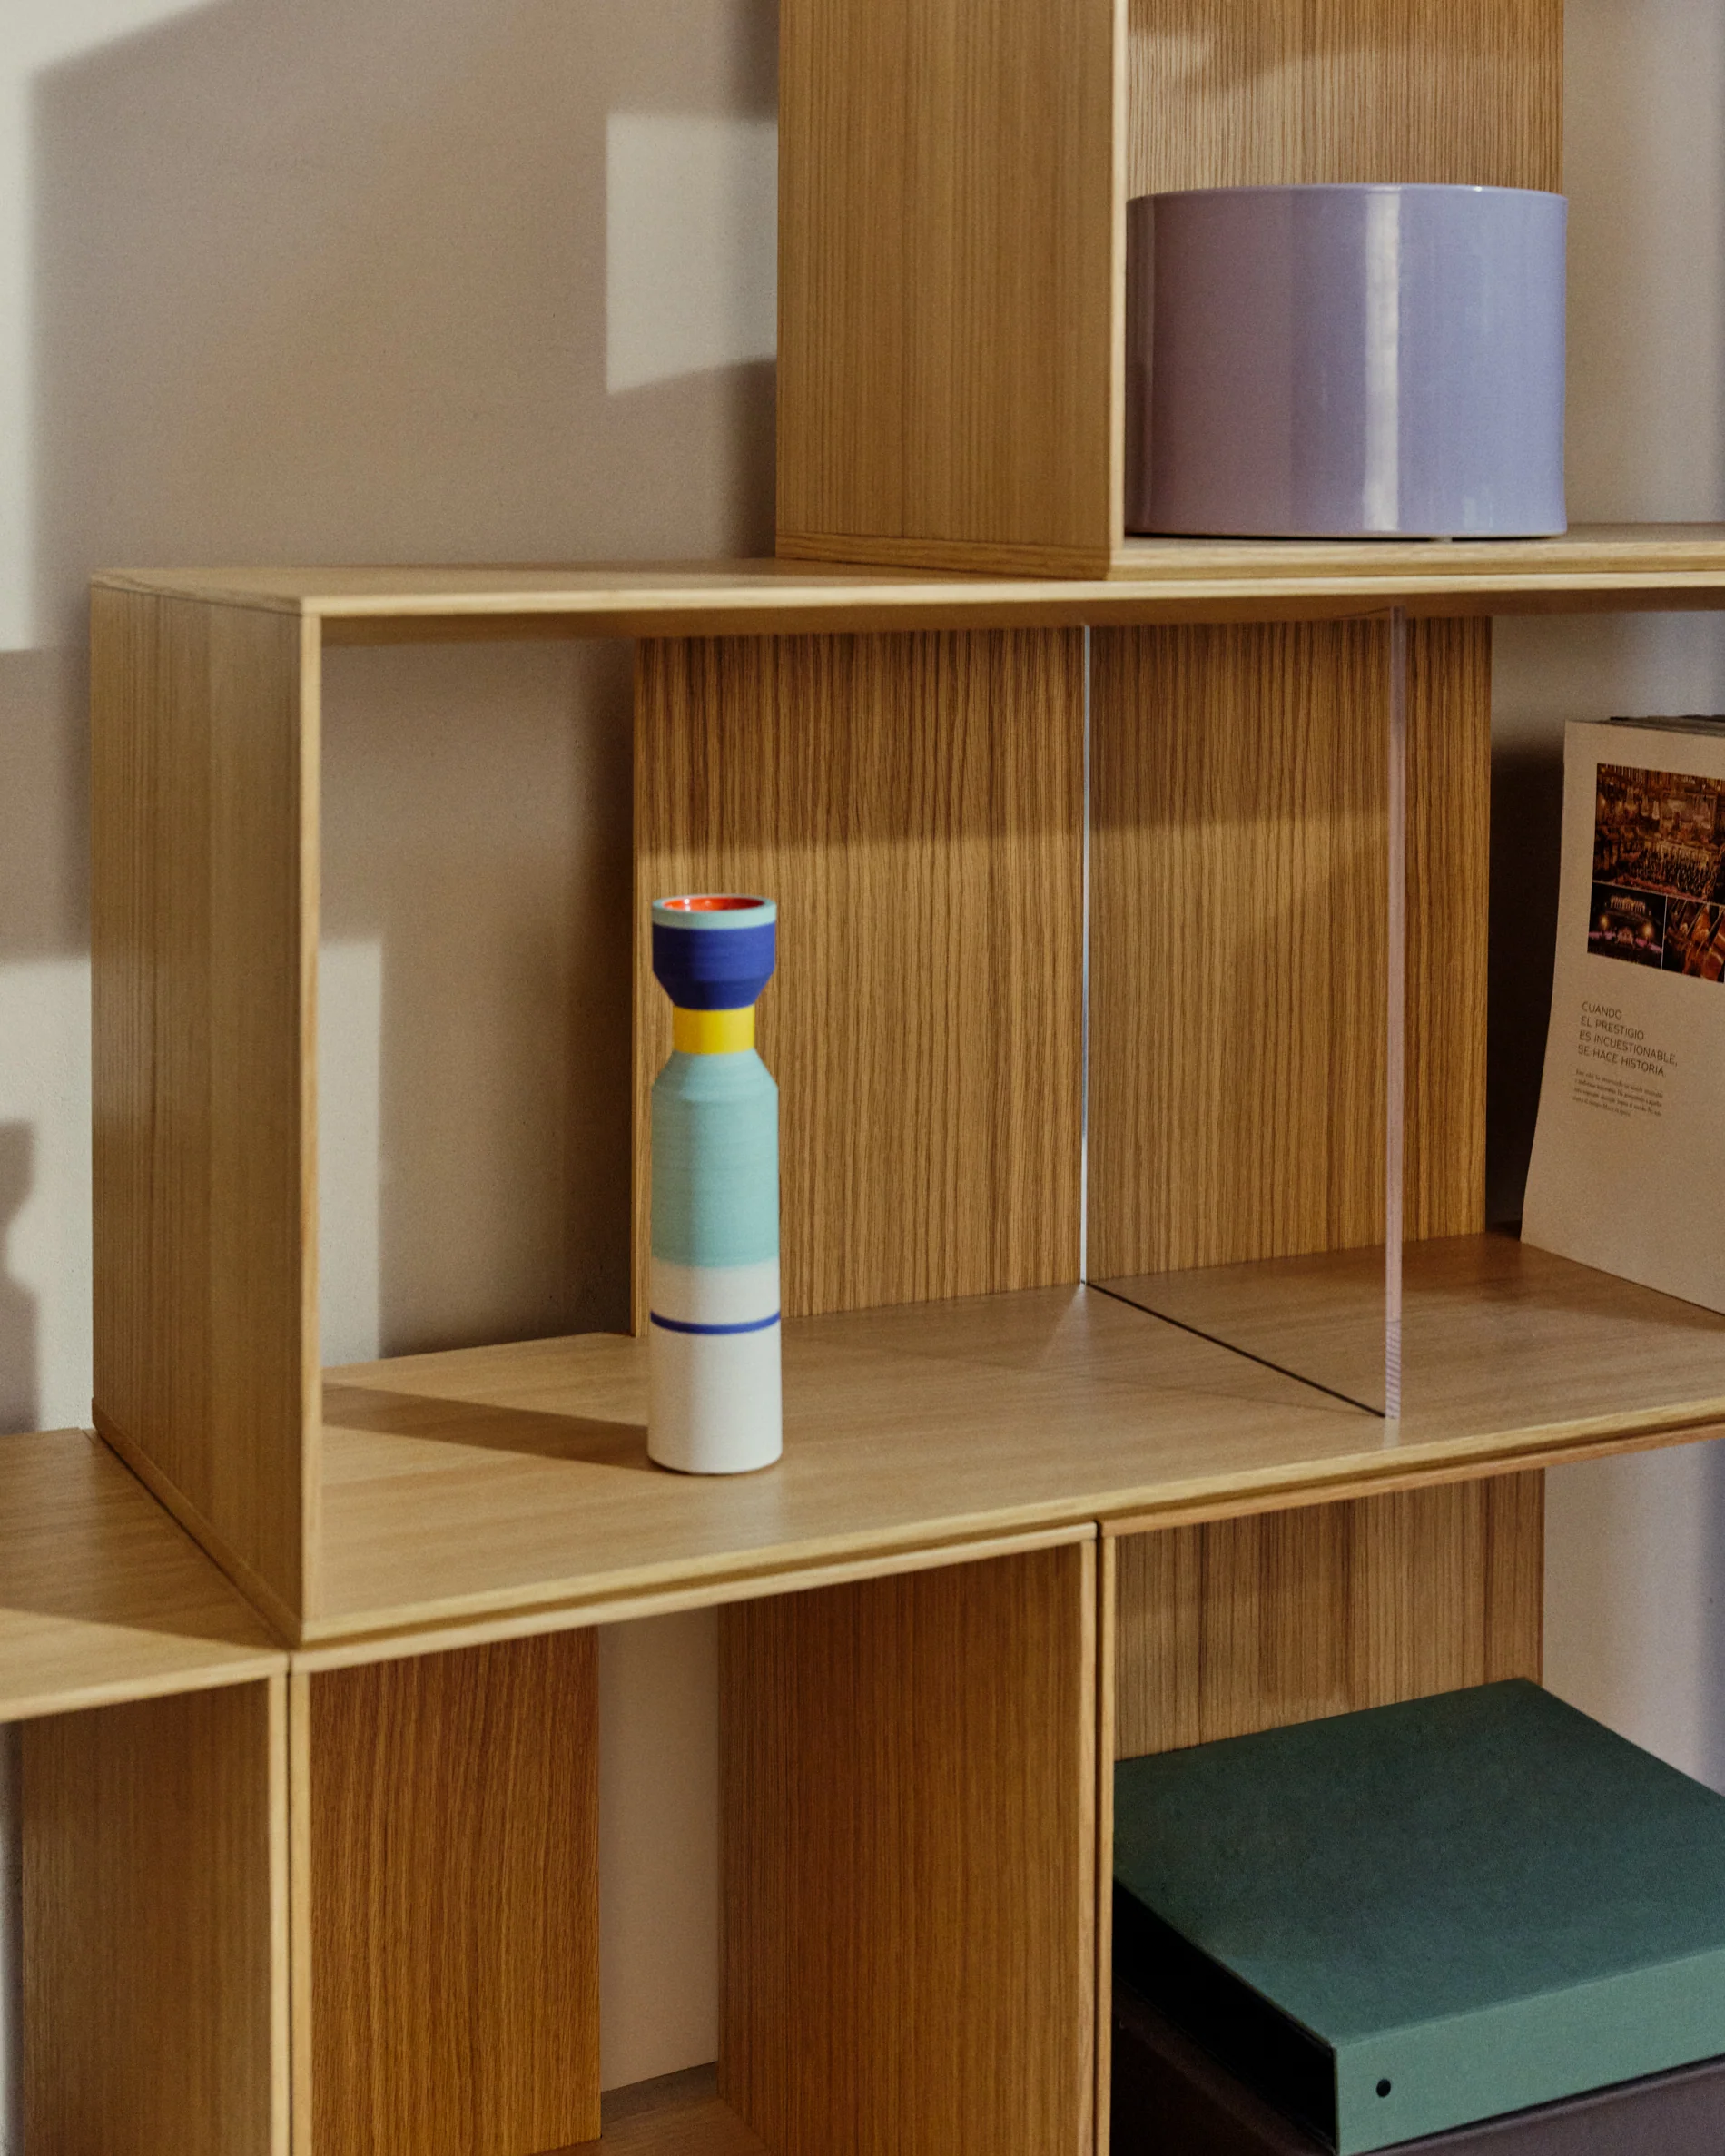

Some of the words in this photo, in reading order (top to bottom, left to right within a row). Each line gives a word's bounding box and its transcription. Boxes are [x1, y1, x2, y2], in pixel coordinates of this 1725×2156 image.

[1582, 1001, 1622, 1020] CUANDO
[1581, 1016, 1592, 1028] EL
[1595, 1019, 1644, 1040] PRESTIGIO
[1578, 1044, 1591, 1057] SE
[1592, 1048, 1618, 1064] HACE
[1579, 1029, 1592, 1042] ES
[1593, 1034, 1678, 1067] INCUESTIONABLE,
